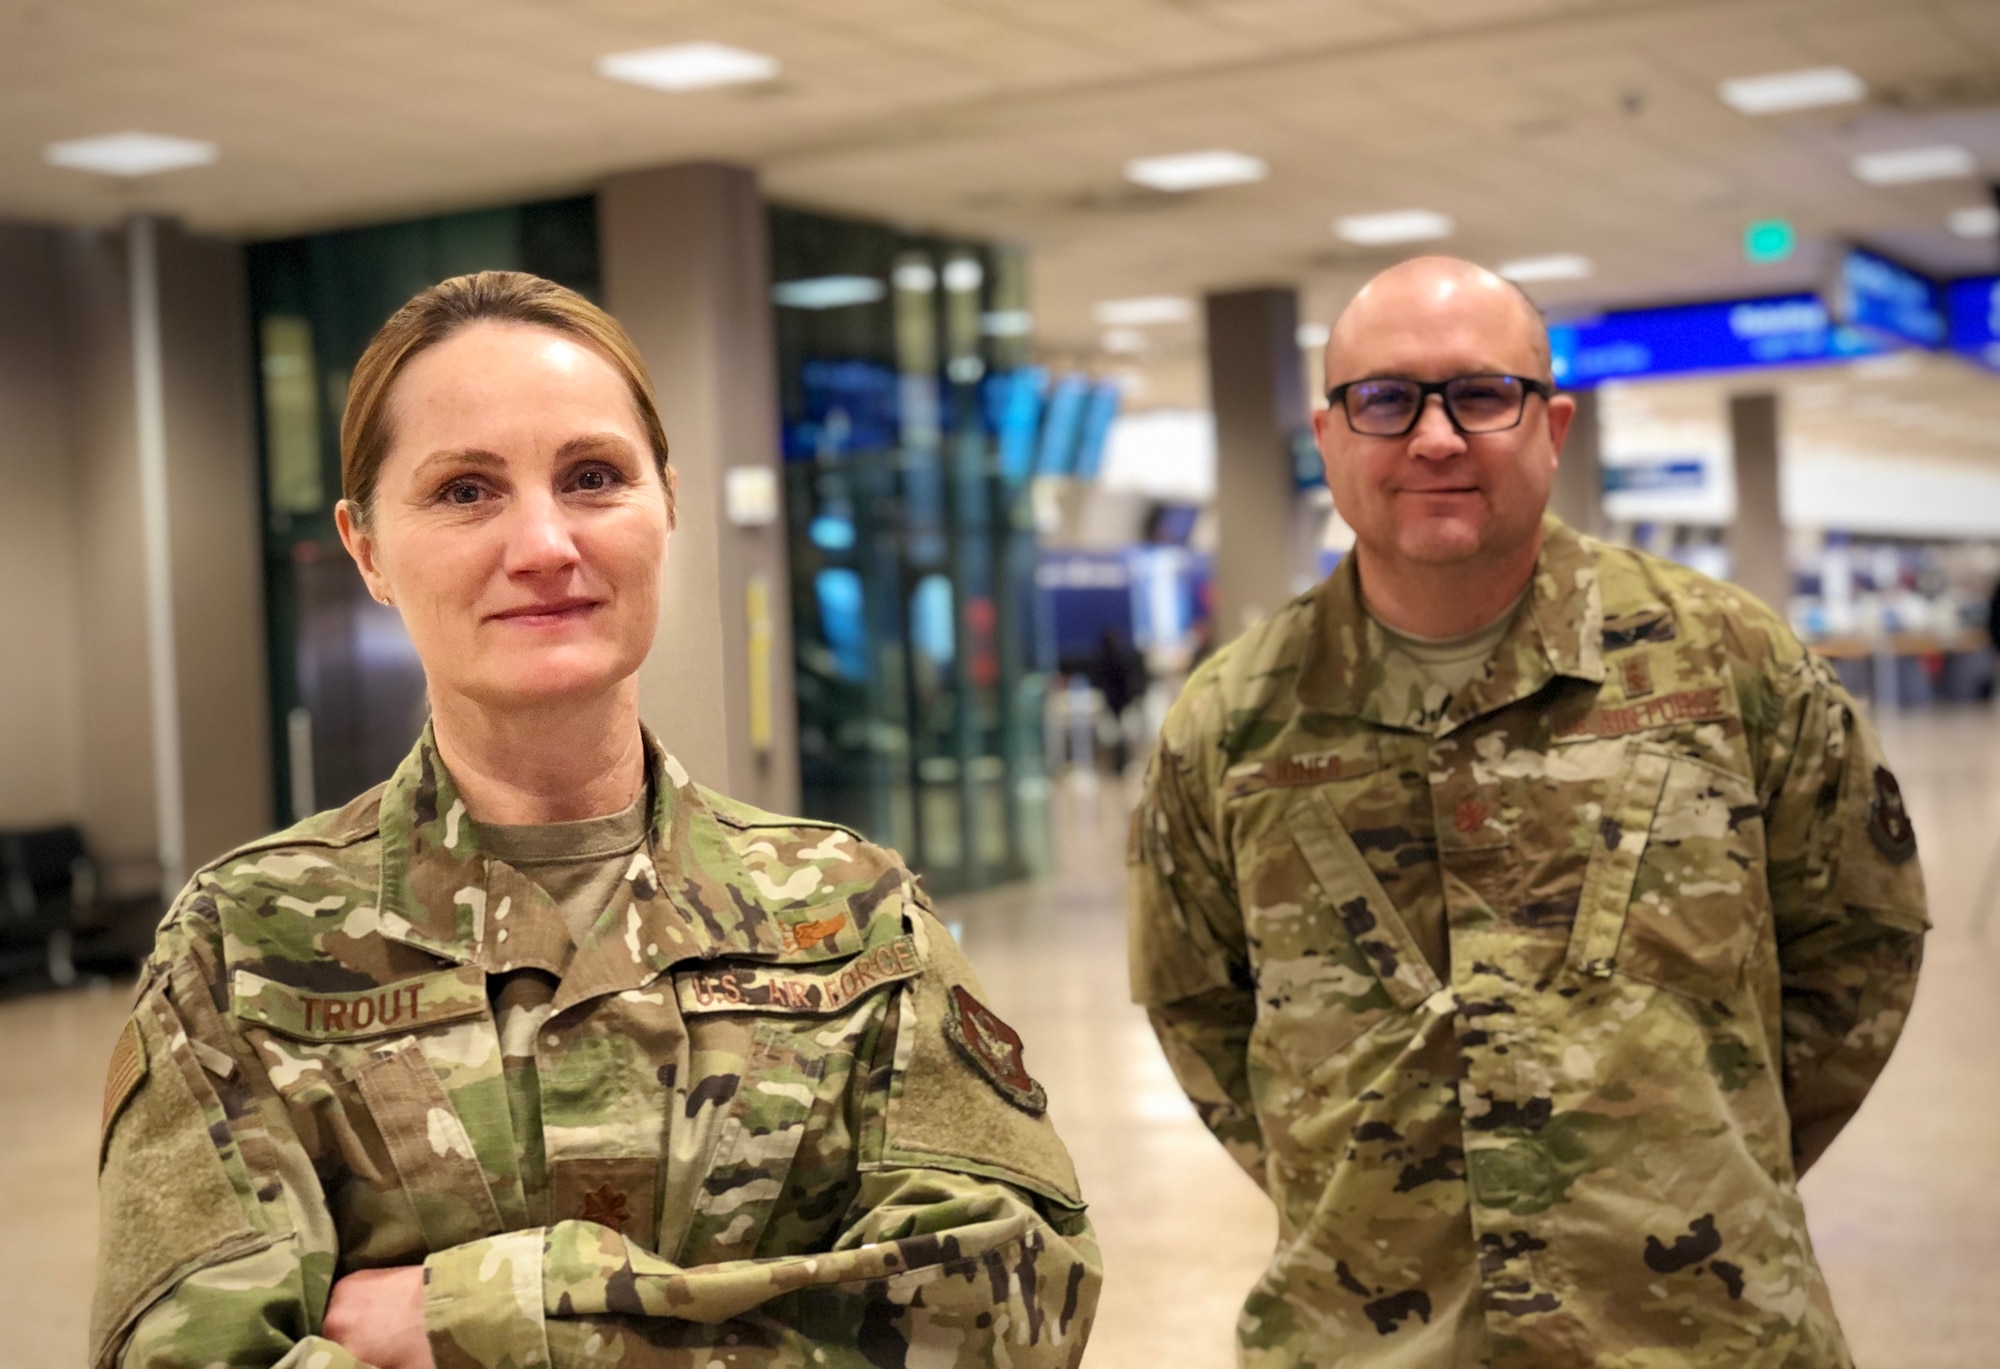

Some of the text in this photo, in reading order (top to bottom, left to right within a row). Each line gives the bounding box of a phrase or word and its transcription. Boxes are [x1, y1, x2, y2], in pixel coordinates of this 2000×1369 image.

[691, 942, 915, 1008] U.S. AIR FORCE
[298, 982, 425, 1032] TROUT
